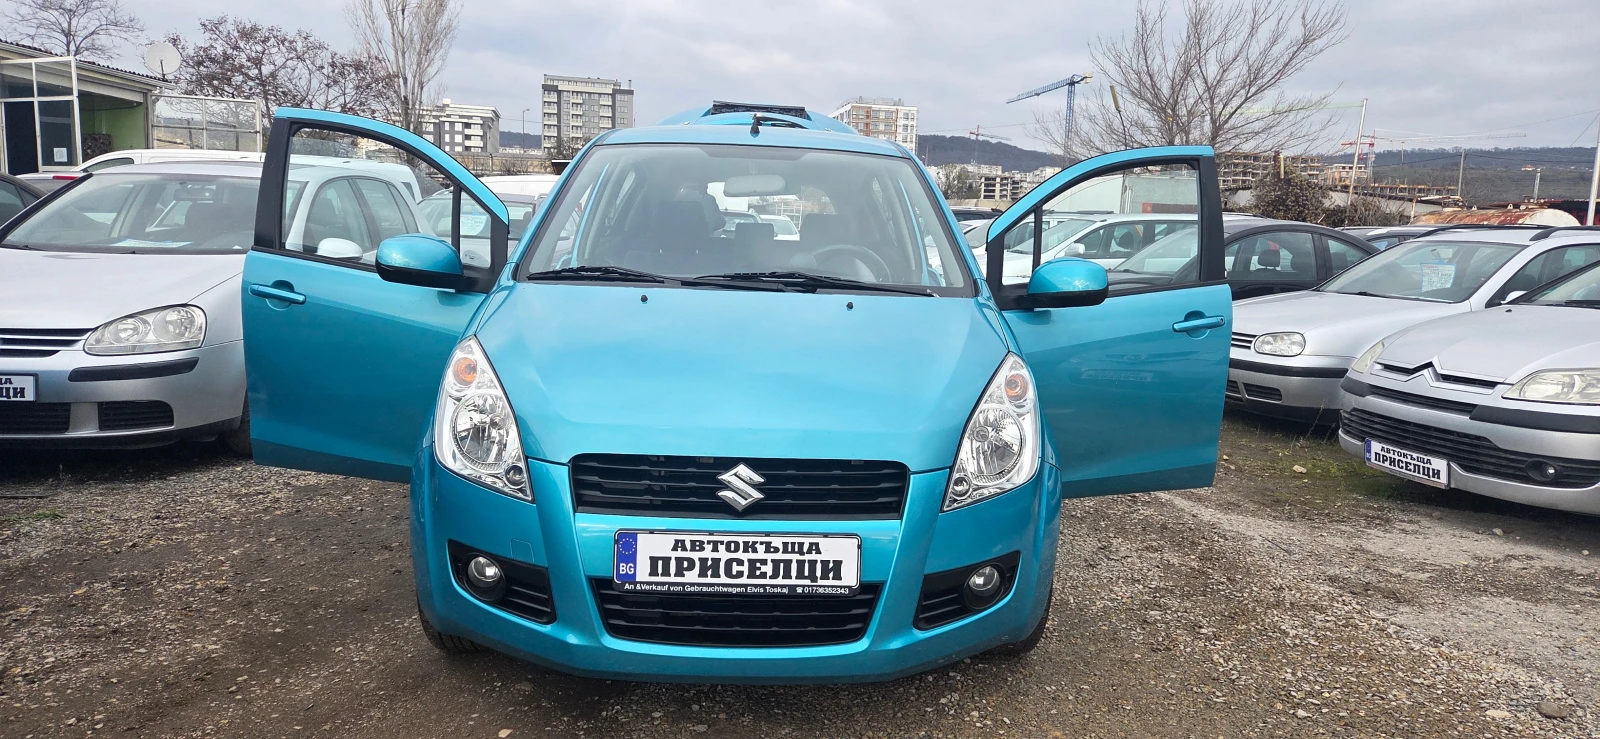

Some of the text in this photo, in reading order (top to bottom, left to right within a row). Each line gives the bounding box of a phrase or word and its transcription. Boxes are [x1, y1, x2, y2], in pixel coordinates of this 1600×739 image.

[1380, 446, 1432, 465] АВТОКЪЩА
[1374, 452, 1441, 480] ПРИСЕЛЦИ
[671, 539, 822, 556] АВТОКЪЩА
[619, 562, 635, 575] BG
[648, 556, 843, 583] ПРИСЕЛЦИ
[684, 585, 746, 594] Gebrauchtwagen
[765, 586, 789, 595] Toskaj
